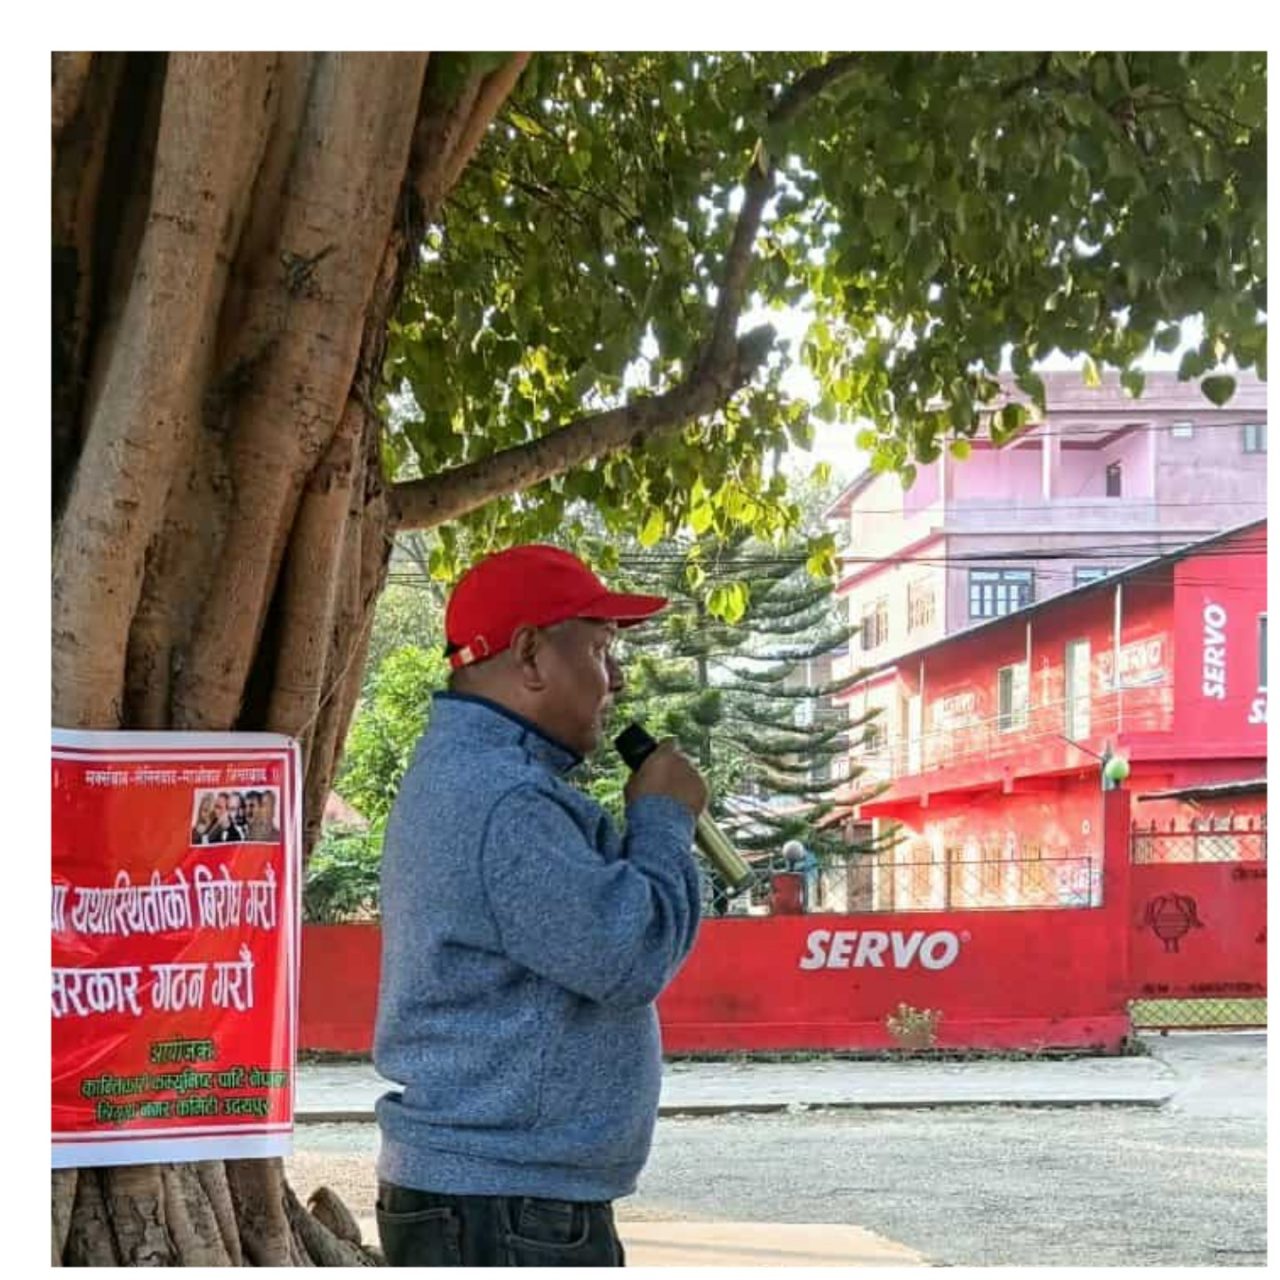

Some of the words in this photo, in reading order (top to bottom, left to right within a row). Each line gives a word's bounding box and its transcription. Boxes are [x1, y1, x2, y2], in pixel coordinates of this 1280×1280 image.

[1202, 603, 1227, 700] SERVO
[799, 929, 960, 971] SERVO
[52, 966, 143, 1018] सरकार
[150, 962, 210, 1012] गठन
